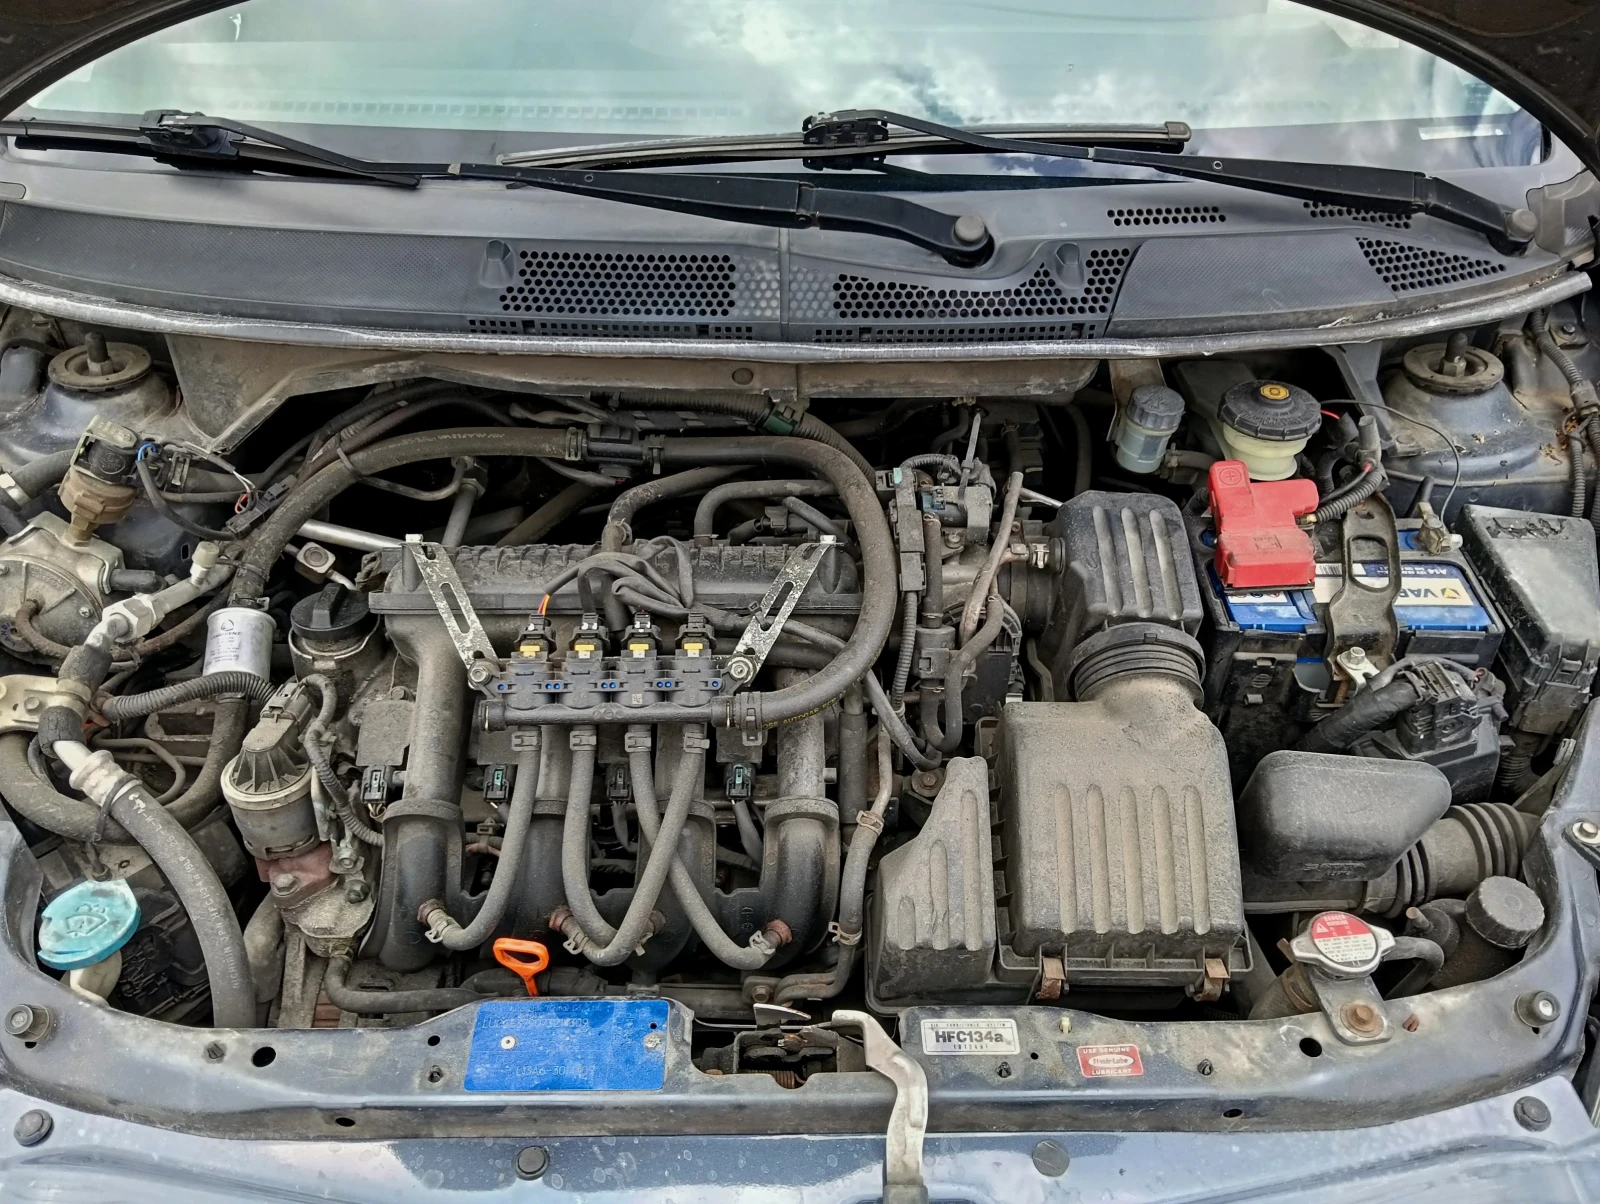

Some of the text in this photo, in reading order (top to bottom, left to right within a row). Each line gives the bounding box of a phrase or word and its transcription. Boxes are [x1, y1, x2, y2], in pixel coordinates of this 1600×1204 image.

[1400, 588, 1439, 598] VAR
[934, 1030, 1004, 1043] HFC134a
[1091, 1068, 1132, 1076] LUBRICANT
